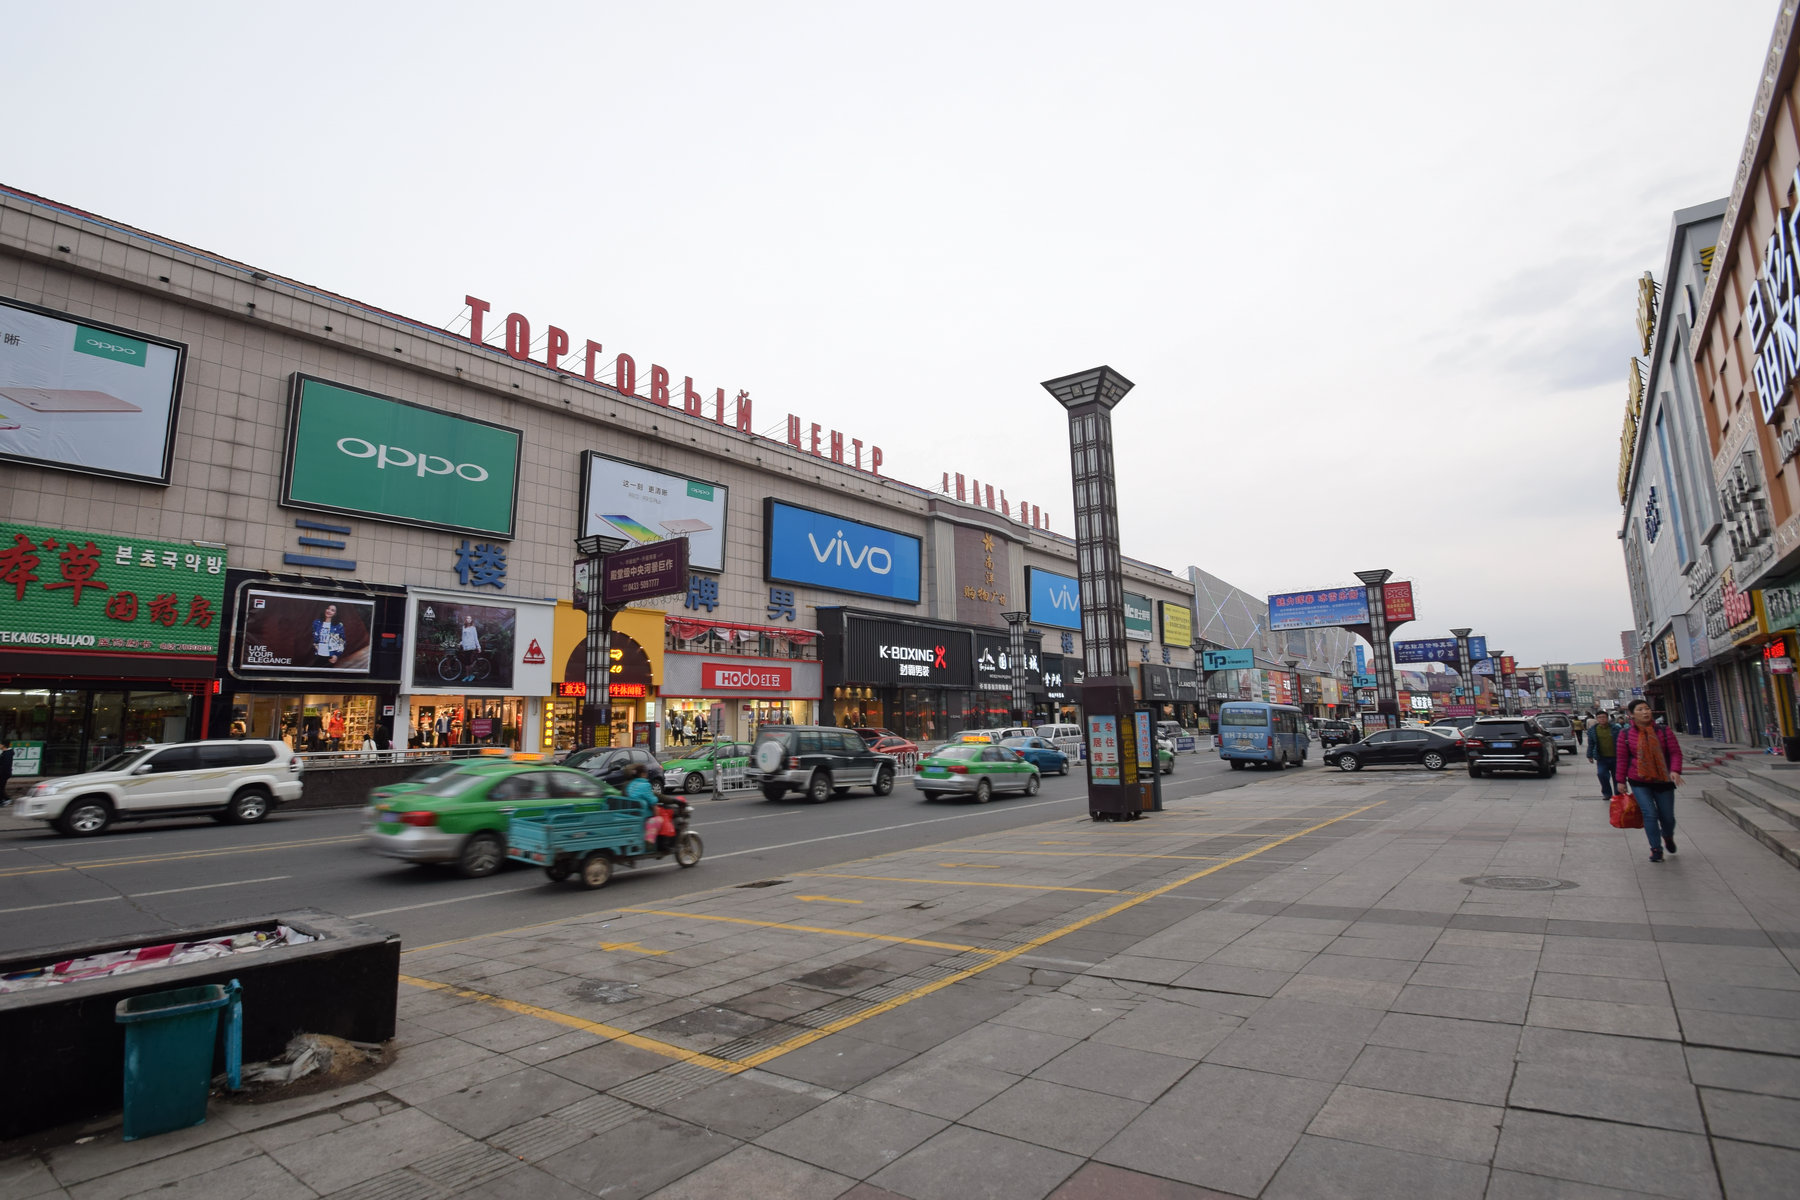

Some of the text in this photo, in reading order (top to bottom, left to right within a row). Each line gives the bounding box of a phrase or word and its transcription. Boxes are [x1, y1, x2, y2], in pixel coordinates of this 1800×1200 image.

[465, 295, 883, 476] ТОРГОВЫЙ ЦЕНТР
[115, 545, 223, 574] 본초국약방
[808, 530, 891, 575] vivo
[105, 590, 217, 629] 国药房
[1048, 584, 1081, 612] viv
[247, 657, 292, 665] ELEGANCE
[880, 645, 934, 662] K-BOXING
[899, 663, 930, 677] 劲霸男装
